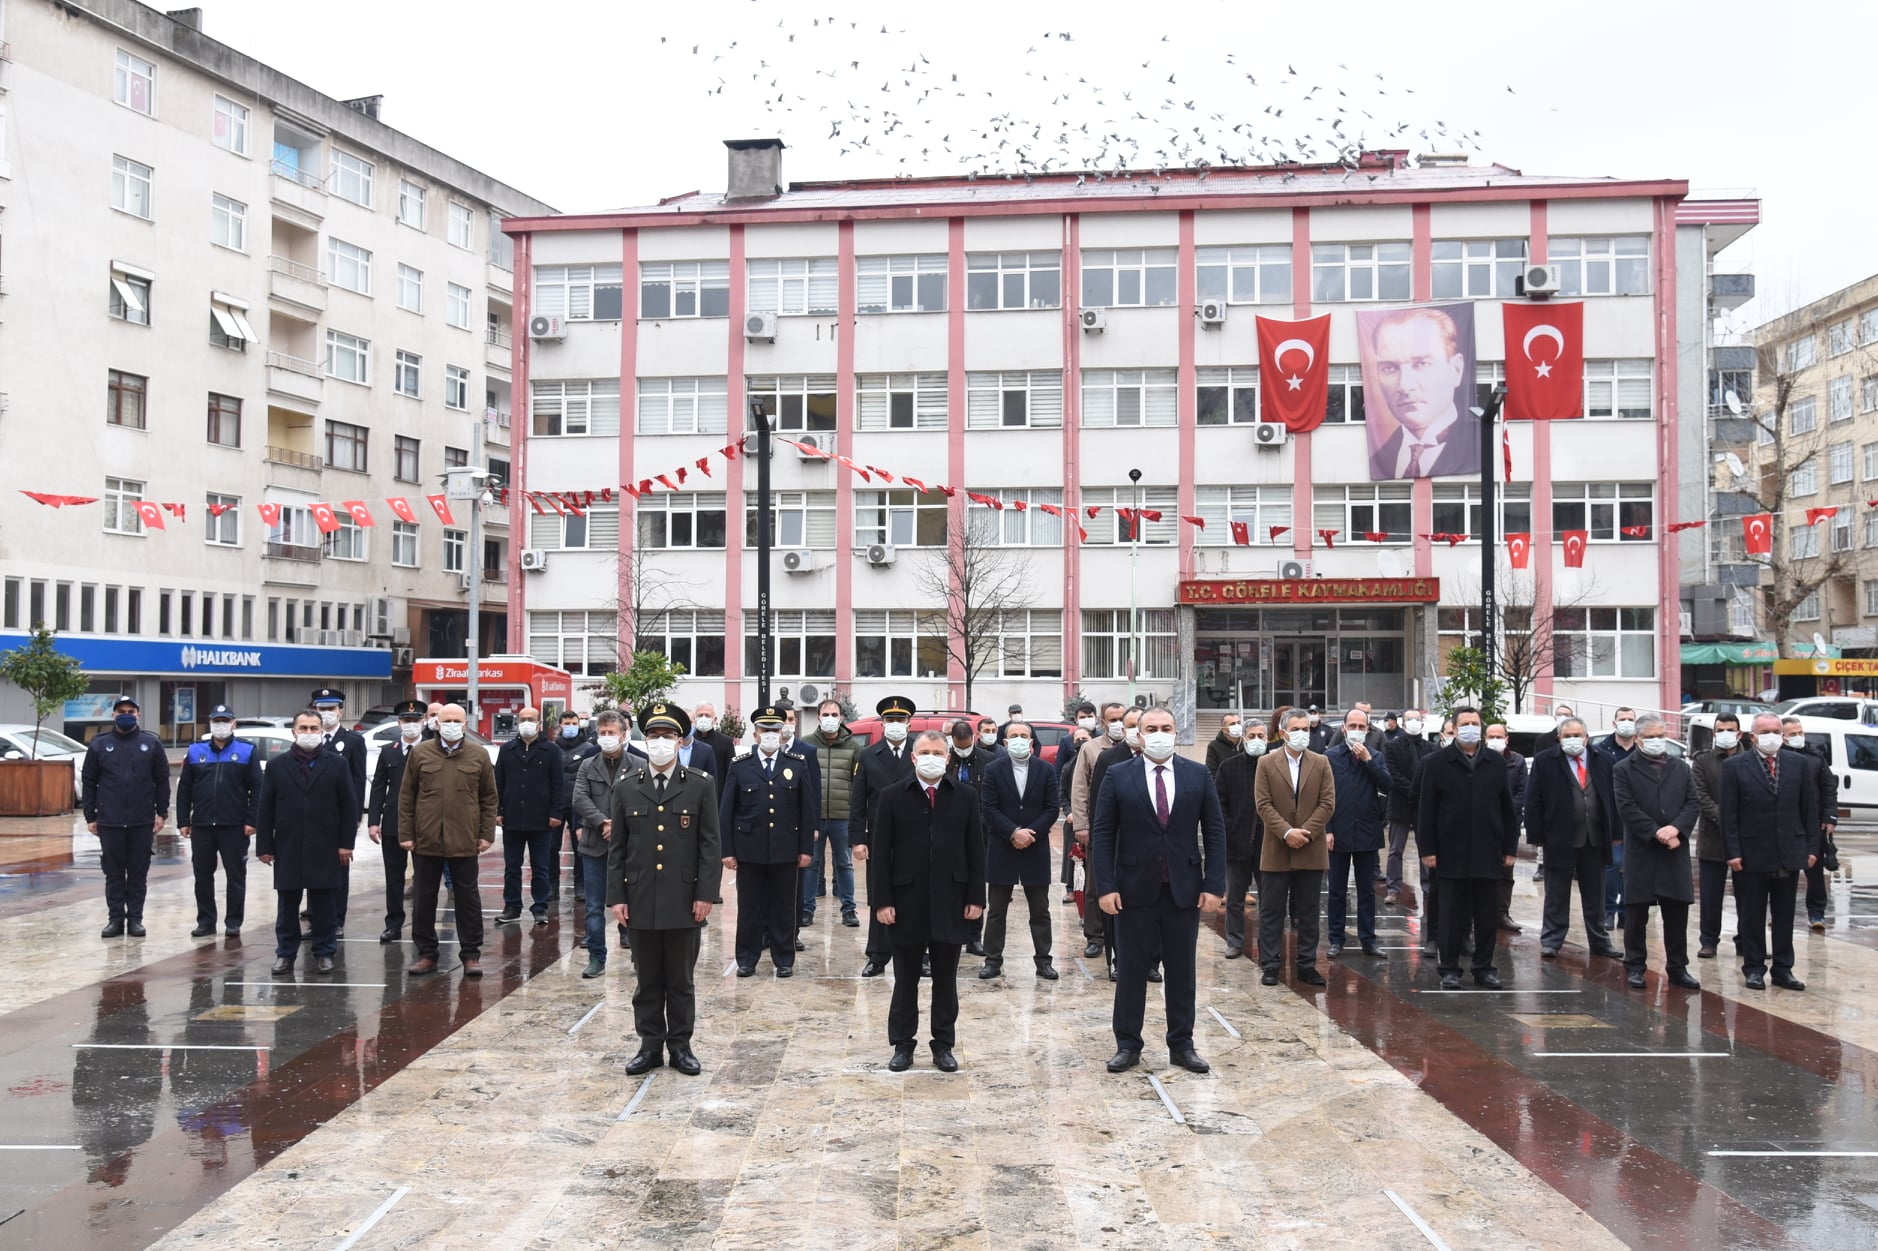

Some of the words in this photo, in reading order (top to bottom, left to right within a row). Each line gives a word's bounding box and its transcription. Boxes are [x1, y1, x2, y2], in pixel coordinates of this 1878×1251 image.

[1186, 585, 1217, 599] T.C.
[1222, 583, 1292, 599] GÖRELE
[1298, 580, 1433, 597] KAYMAKAMLIĞI
[196, 650, 261, 667] HALKBANK
[477, 668, 503, 678] ankası
